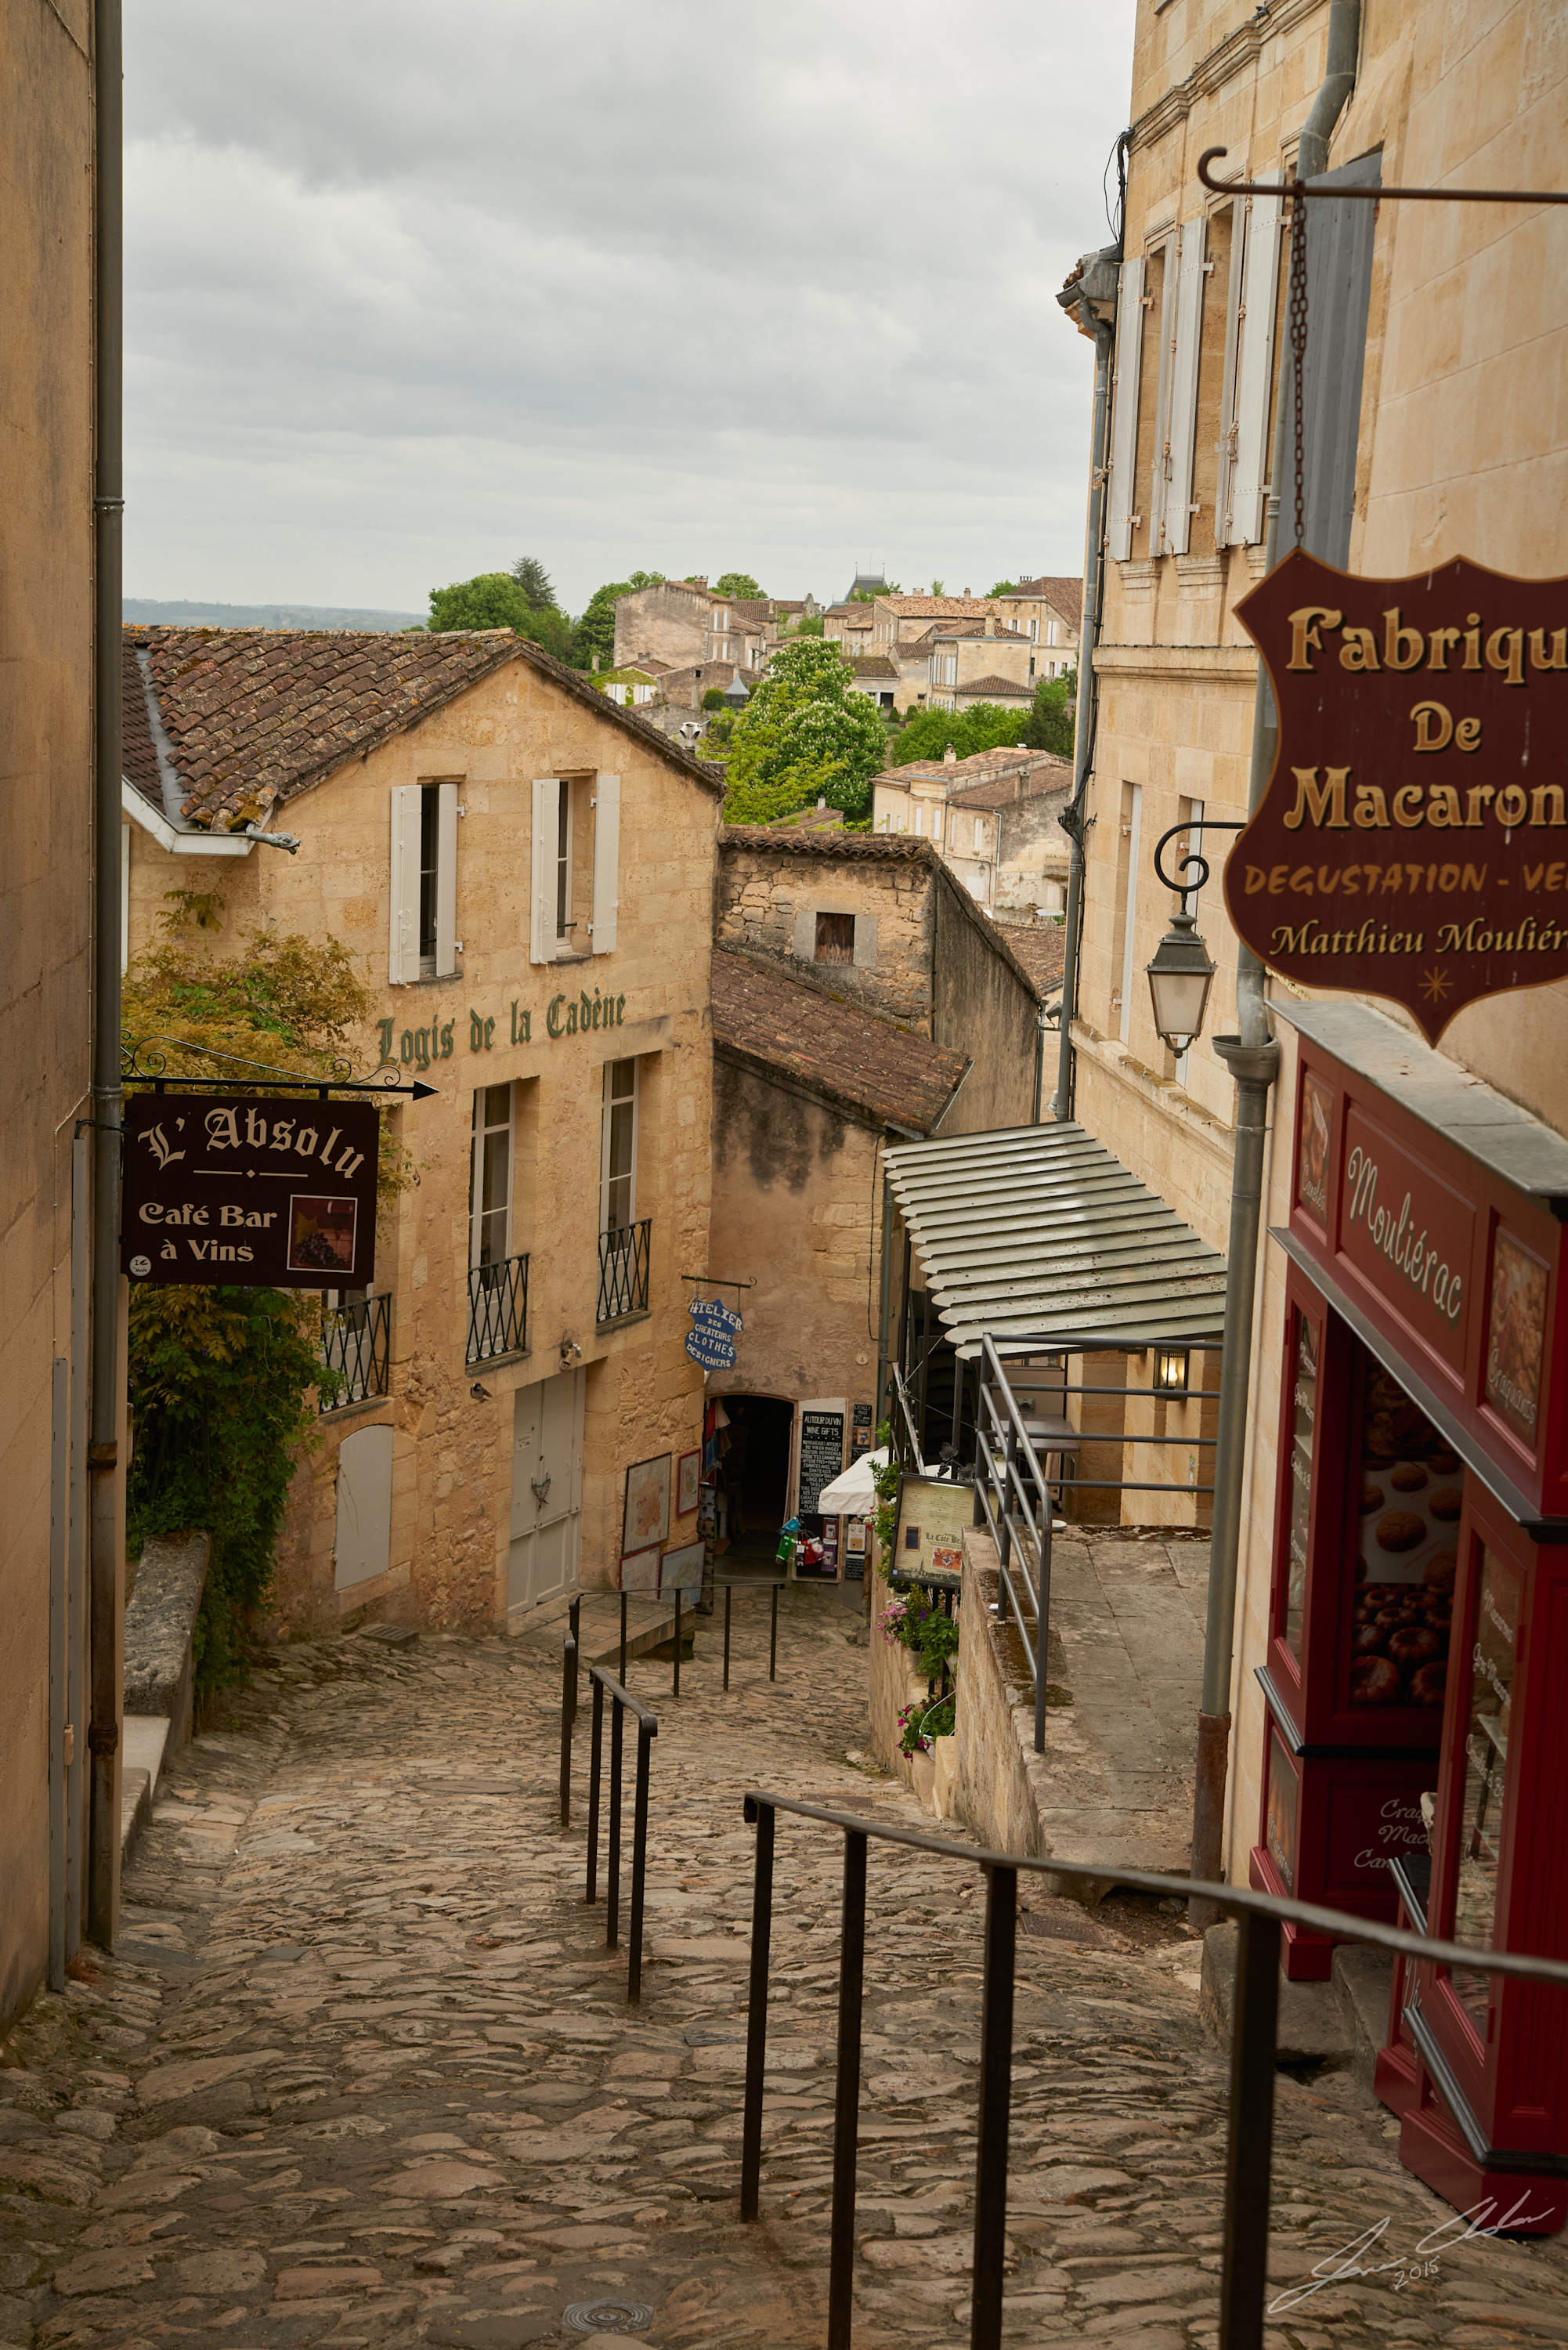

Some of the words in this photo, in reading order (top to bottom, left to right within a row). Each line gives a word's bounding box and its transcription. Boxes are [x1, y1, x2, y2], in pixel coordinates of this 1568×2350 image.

[1411, 701, 1482, 751] De
[1244, 863, 1487, 895] DEGUSTATION
[1523, 862, 1568, 891] VE
[1270, 919, 1424, 955] Matthieu
[1436, 916, 1568, 953] Mouliér
[376, 1015, 455, 1071] Logis
[470, 1007, 496, 1053] de
[511, 998, 532, 1045] la
[546, 987, 626, 1039] Cadène
[138, 1202, 210, 1226] Café
[219, 1205, 278, 1228] Bar
[1348, 1146, 1462, 1318] Mouliérac
[160, 1238, 178, 1260] à
[187, 1239, 255, 1263] Vins
[689, 1302, 742, 1332] ATELIER
[707, 1318, 722, 1328] DES
[688, 1332, 735, 1358] CLOTHES
[695, 1323, 732, 1343] CREATEURS
[686, 1343, 731, 1368] DESIGNERS
[1488, 1347, 1537, 1425] Craquants
[804, 1415, 825, 1426] AUTOUR
[825, 1417, 833, 1426] DU
[833, 1417, 841, 1426] VIN
[806, 1426, 820, 1435] WINE
[821, 1427, 839, 1436] GIFTS
[1378, 1825, 1429, 1845] Mac
[1269, 1813, 1293, 1887] Macarons
